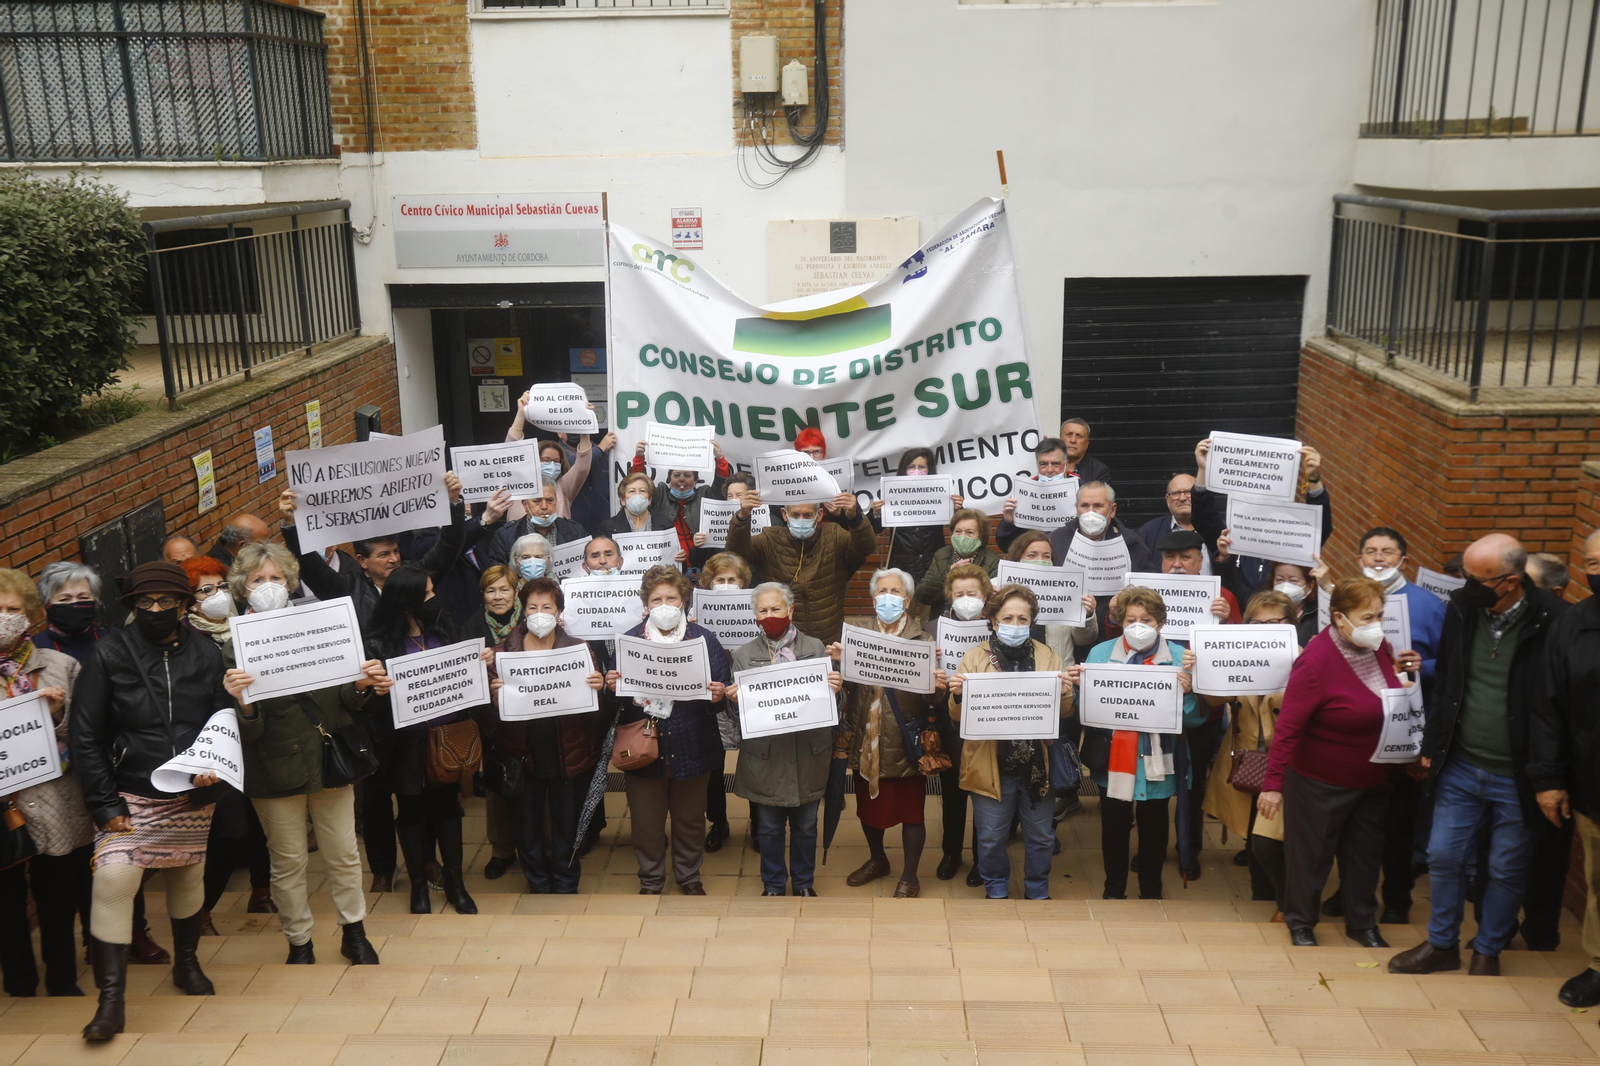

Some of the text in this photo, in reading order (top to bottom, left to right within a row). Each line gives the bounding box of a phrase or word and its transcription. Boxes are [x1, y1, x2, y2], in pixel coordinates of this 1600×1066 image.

[401, 202, 599, 219] Centro Cívico Municipal Sebastián Cuevas
[456, 254, 507, 263] AYUNTAMIENTO
[508, 254, 516, 262] DE
[851, 271, 875, 279] CUEVAS
[638, 316, 1003, 387] CONSEJO DE DISTRITO
[615, 360, 1034, 443] PONIENTE SUR
[1214, 445, 1294, 461] INCUMPLIMIENTO
[493, 455, 525, 465] CIERRE
[1222, 458, 1280, 470] REGLAMENTO
[291, 447, 440, 486] NO A DESILUSIONES NUEVAS
[771, 475, 819, 486] CIUDADANA
[1219, 468, 1283, 482] PARTICIPACIÓN
[306, 472, 433, 507] QUEREMOS ABIERTO
[888, 486, 947, 495] AYUNTAMIENTO,
[1222, 479, 1271, 491] CIUDADANA
[785, 489, 807, 497] REAL
[1040, 491, 1068, 499] CIERRE
[903, 508, 936, 516] CÓRDOBA
[1015, 512, 1045, 523] CENTROS
[306, 515, 323, 531] EL
[622, 540, 672, 552] NO AL CIERRE
[1007, 575, 1079, 589] AYUNTAMIENTO,
[571, 588, 640, 599] PARTICIPACIÓN
[577, 606, 627, 615] CIUDADANA
[590, 621, 613, 629] REAL
[245, 623, 348, 648] POR LA ATENCIÓN PRESENCIAL,
[719, 630, 760, 638] CÓRDOBA
[847, 637, 930, 660] INCUMPLIMIENTO
[1204, 639, 1287, 650] PARTICIPACIÓN
[247, 638, 352, 664] QUE NO NOS QUITEN SERVICIOS
[627, 649, 694, 664] NO AL CIERRE
[945, 649, 954, 657] LA
[260, 654, 345, 677] DE LOS CENTROS CÍVICOS
[856, 651, 916, 668] REGLAMENTO
[1212, 659, 1270, 668] CIUDADANA
[395, 652, 479, 682] INCUMPLIMIENTO
[510, 659, 585, 677] PARTICIPACIÓN
[646, 668, 678, 678] DE LOS
[854, 659, 921, 677] PARTICIPACIÓN
[408, 668, 468, 691] REGLAMENTO
[748, 672, 824, 693] PARTICIPACIÓN
[858, 669, 910, 685] CIUDADANA
[1228, 675, 1254, 683] REAL
[518, 680, 572, 693] CIUDADANA
[624, 677, 703, 691] CENTROS CÍVICOS
[1093, 679, 1173, 691] PARTICIPACIÓN
[406, 677, 474, 704] PARTICIPACIÓN
[412, 693, 464, 714] CIUDADANA
[533, 697, 558, 707] REAL
[757, 694, 811, 709] CIUDADANA
[1100, 697, 1156, 707] CIUDADANA
[774, 711, 799, 722] REAL
[1022, 714, 1044, 722] CÍVICOS
[1115, 712, 1140, 720] REAL
[199, 749, 238, 773] CÍVICOS
